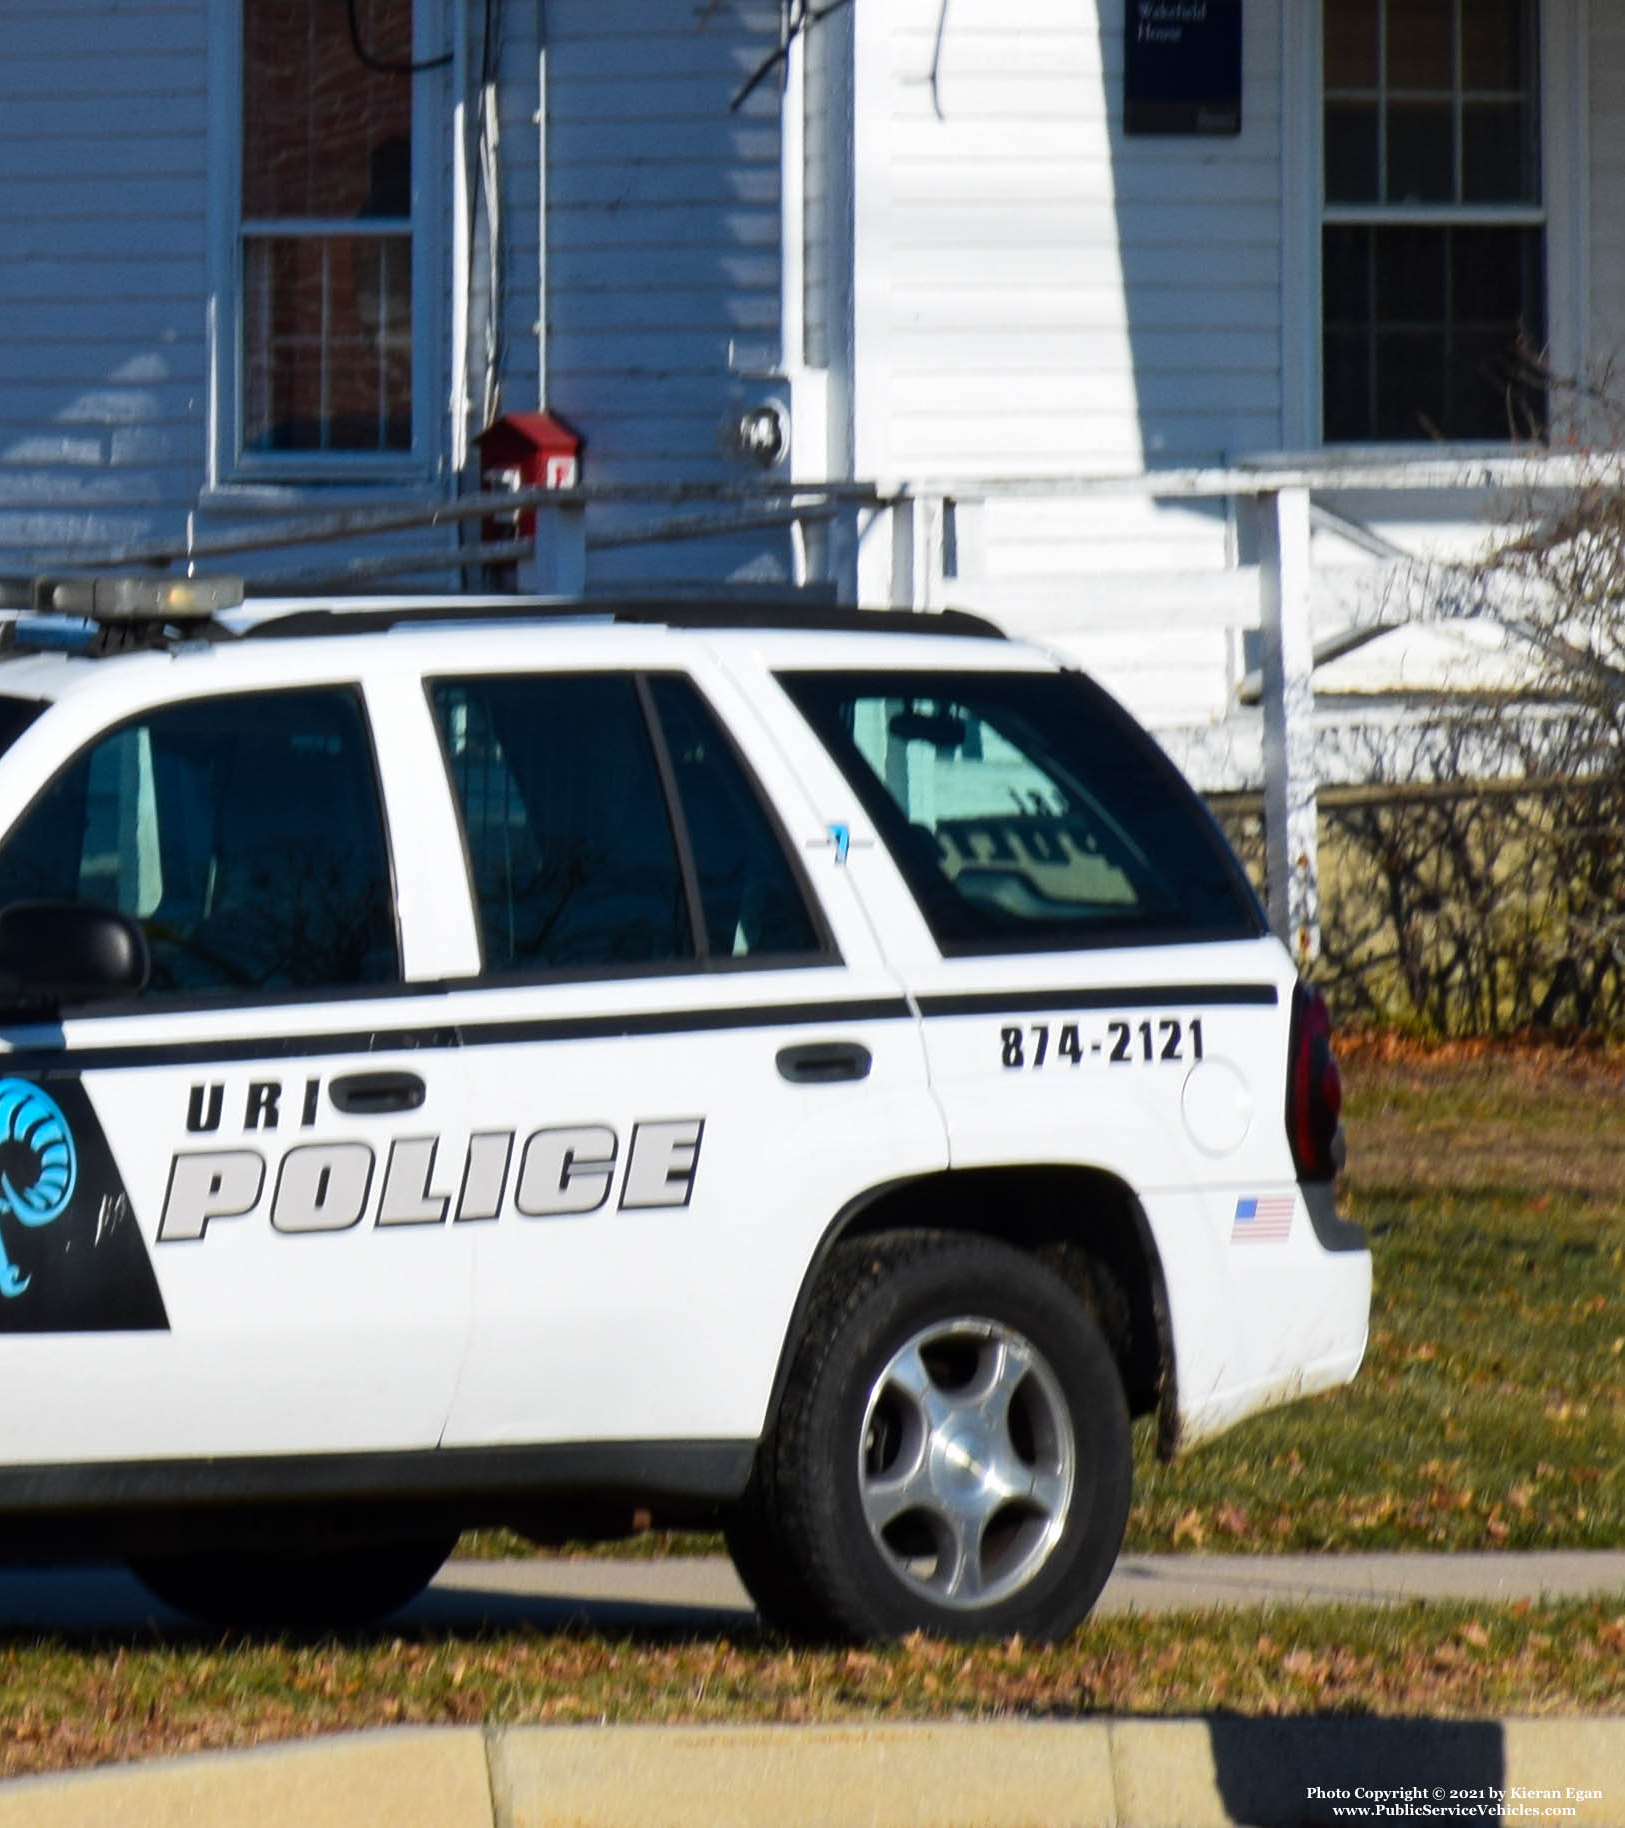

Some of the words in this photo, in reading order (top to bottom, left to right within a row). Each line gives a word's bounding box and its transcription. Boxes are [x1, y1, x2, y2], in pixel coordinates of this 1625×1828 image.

[1000, 1017, 1203, 1068] 874-2121
[185, 1076, 321, 1132] URI
[156, 1116, 707, 1243] POLICE
